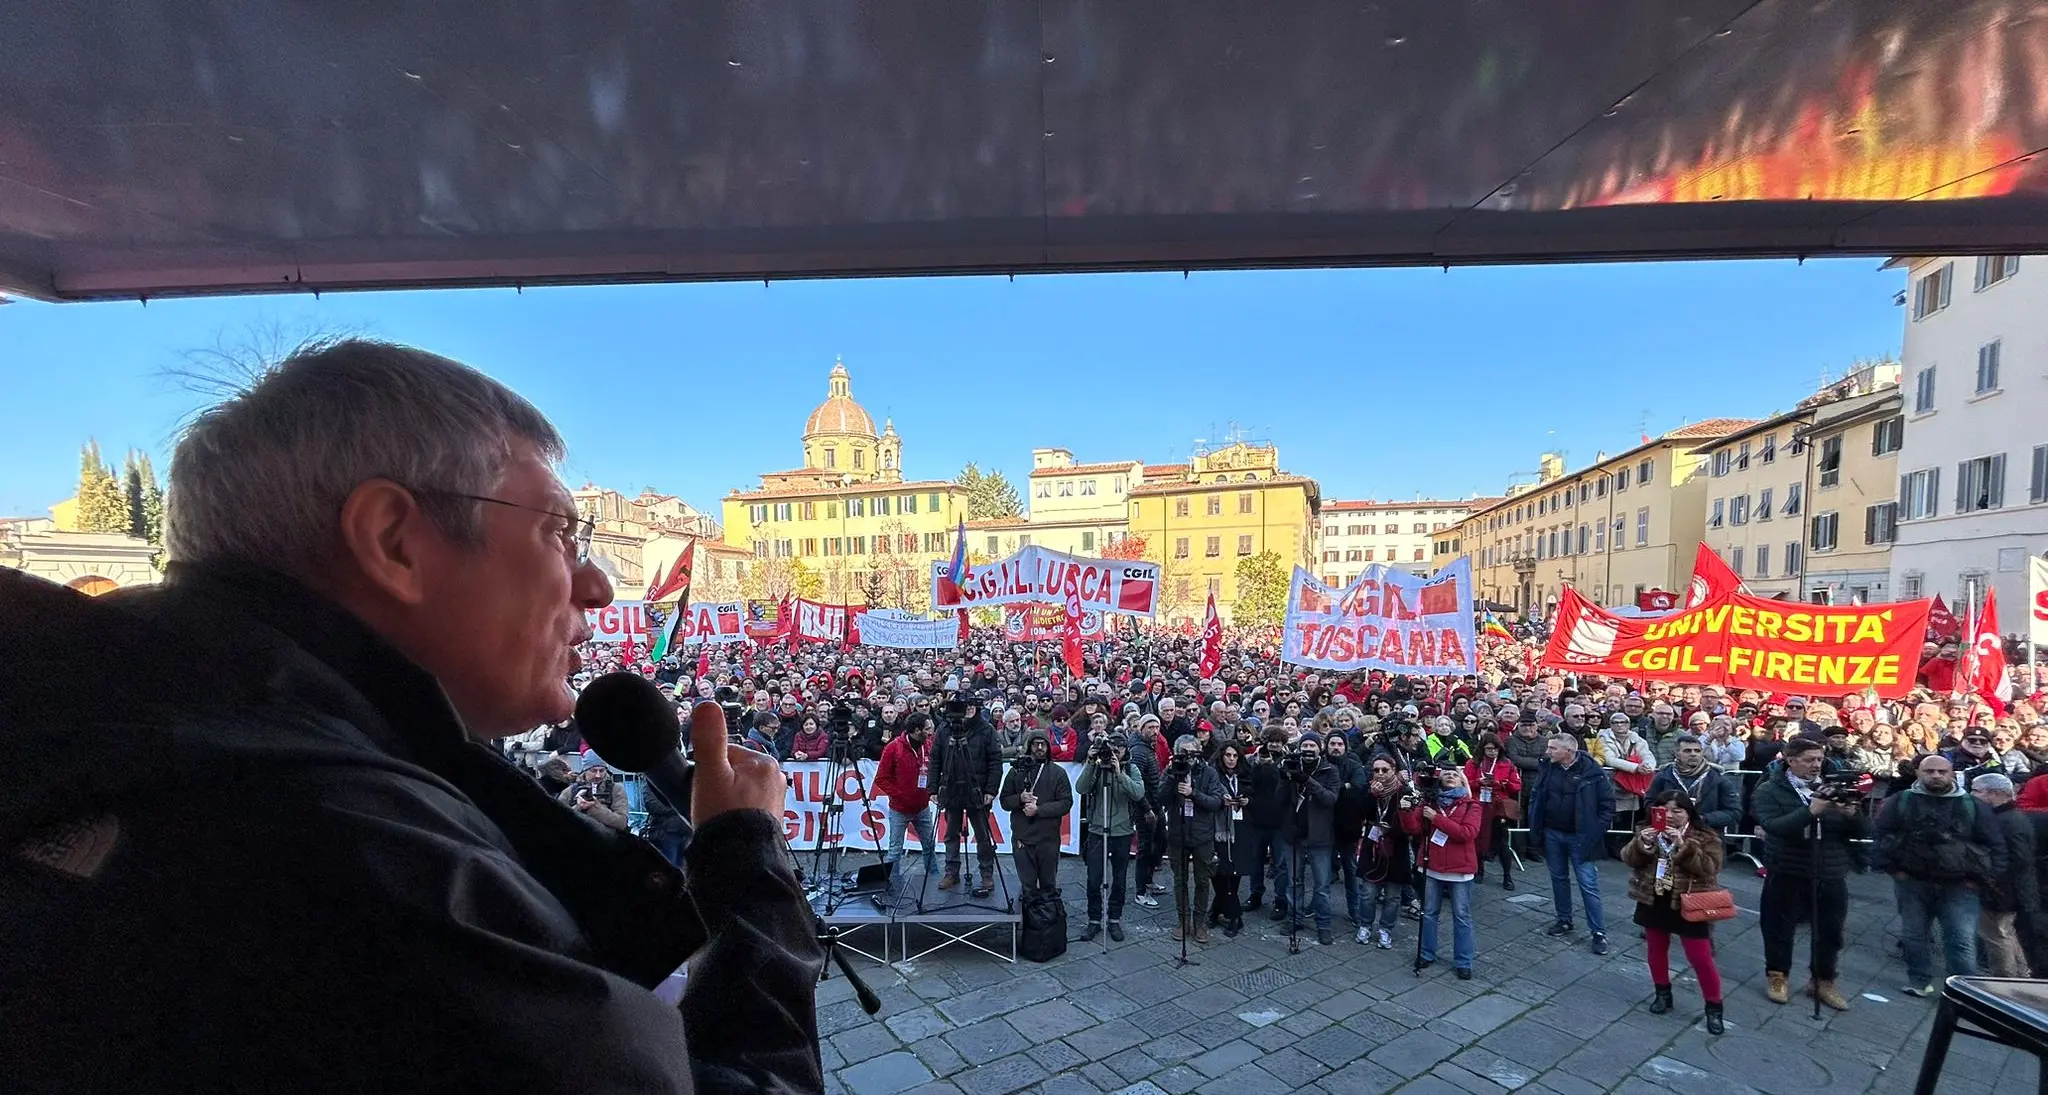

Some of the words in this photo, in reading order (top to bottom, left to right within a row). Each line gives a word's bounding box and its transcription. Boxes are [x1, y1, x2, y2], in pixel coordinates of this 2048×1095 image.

[1123, 568, 1155, 579] CGIL
[717, 604, 738, 613] CGIL
[1297, 622, 1468, 667] TOSCANA
[784, 810, 845, 842] GIL
